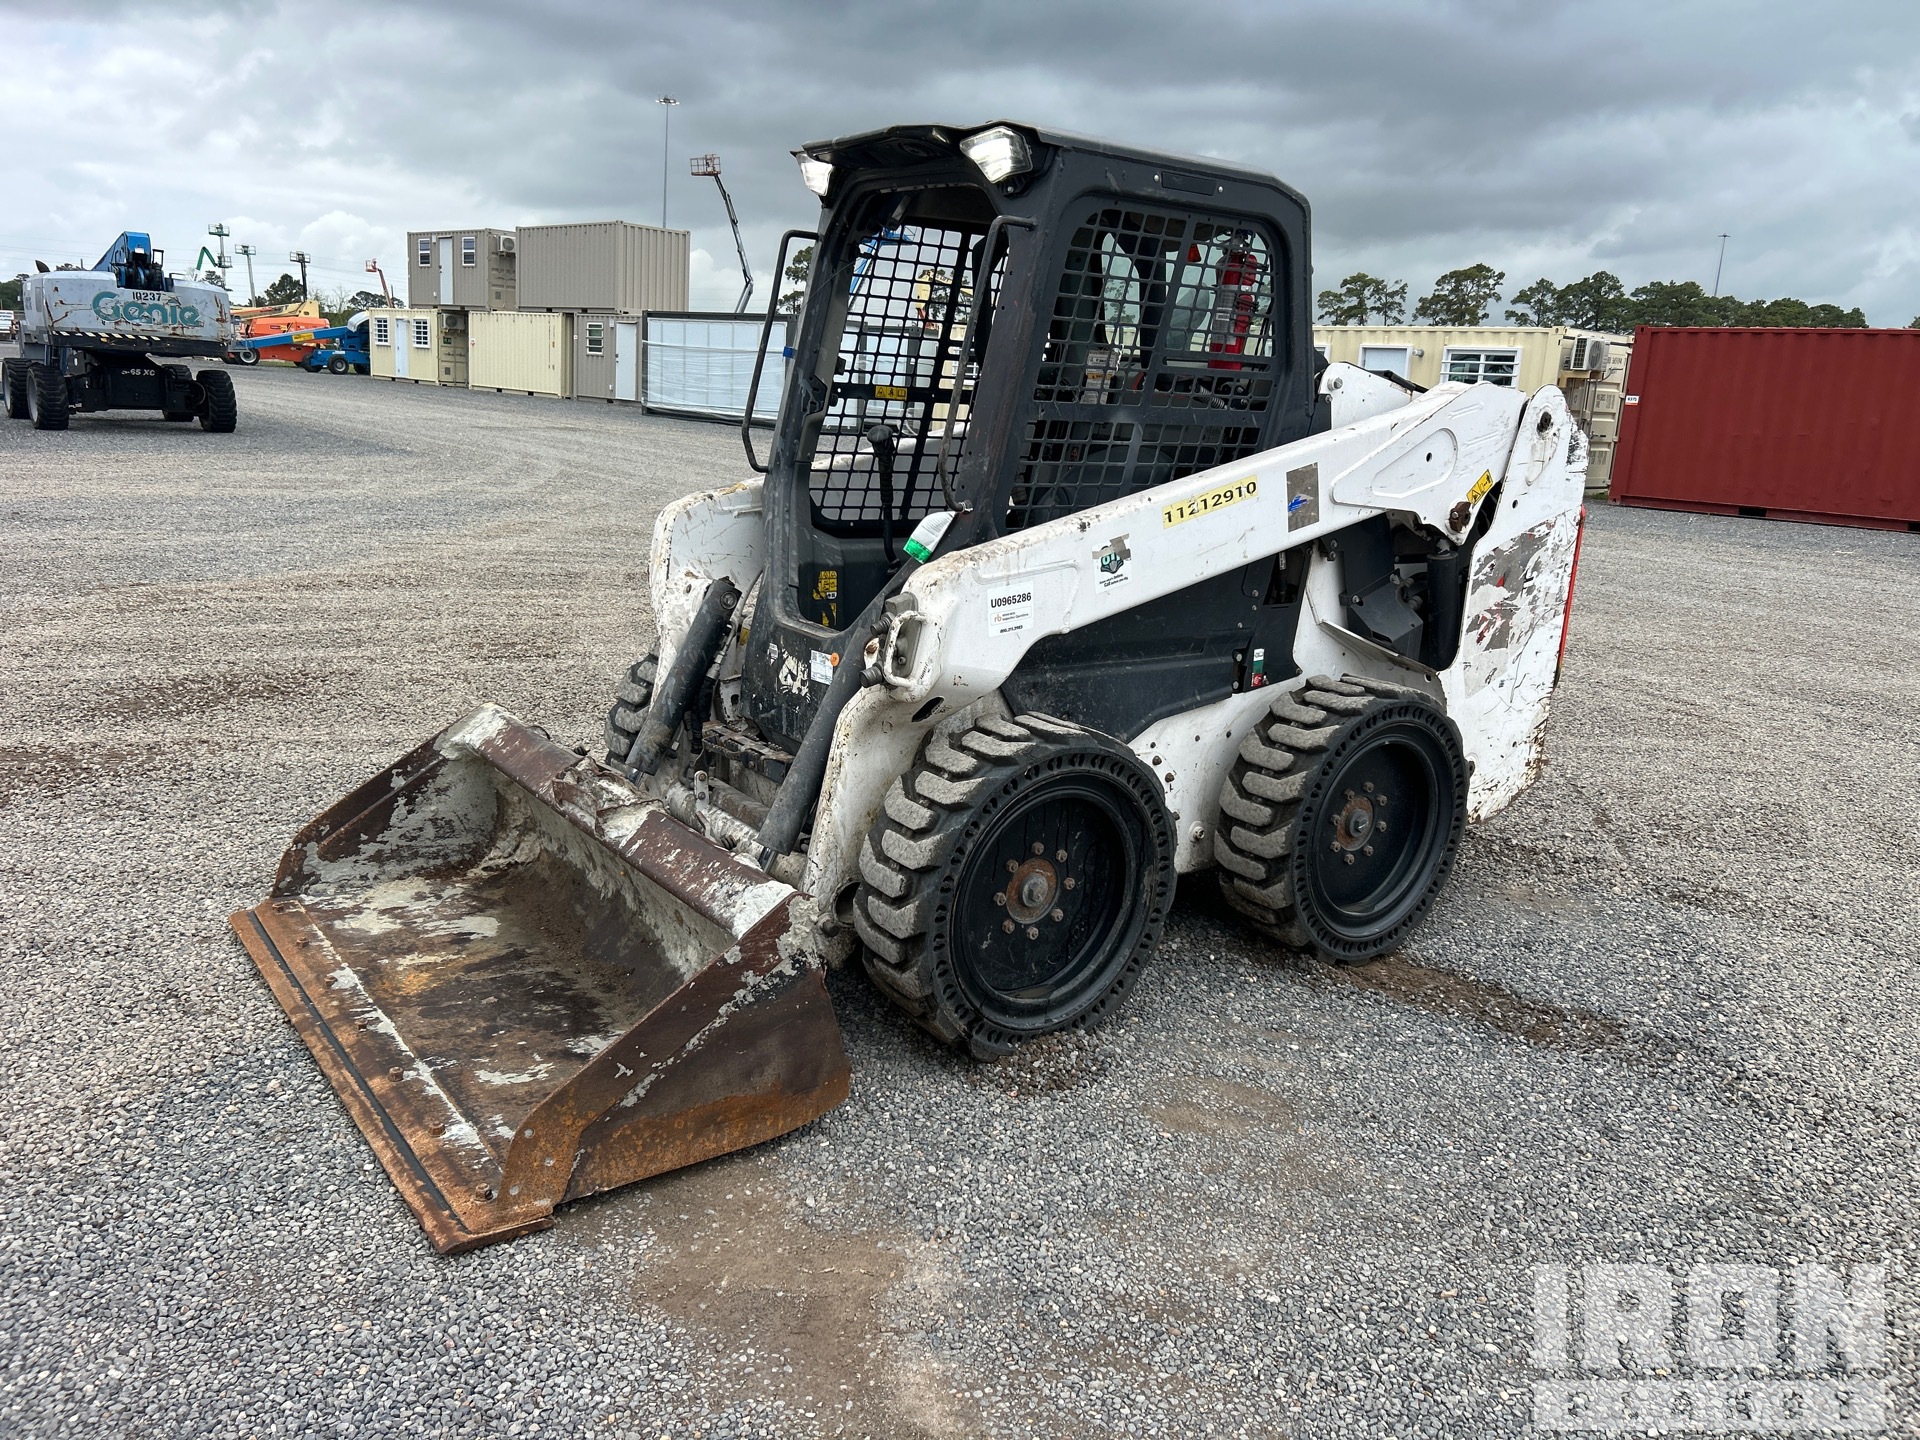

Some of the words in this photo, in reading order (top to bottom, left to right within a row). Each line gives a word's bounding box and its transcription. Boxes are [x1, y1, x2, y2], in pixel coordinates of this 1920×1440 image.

[92, 291, 204, 328] Genie
[143, 369, 156, 377] XC
[1164, 481, 1257, 523] 11212910
[990, 592, 1032, 608] U0965286
